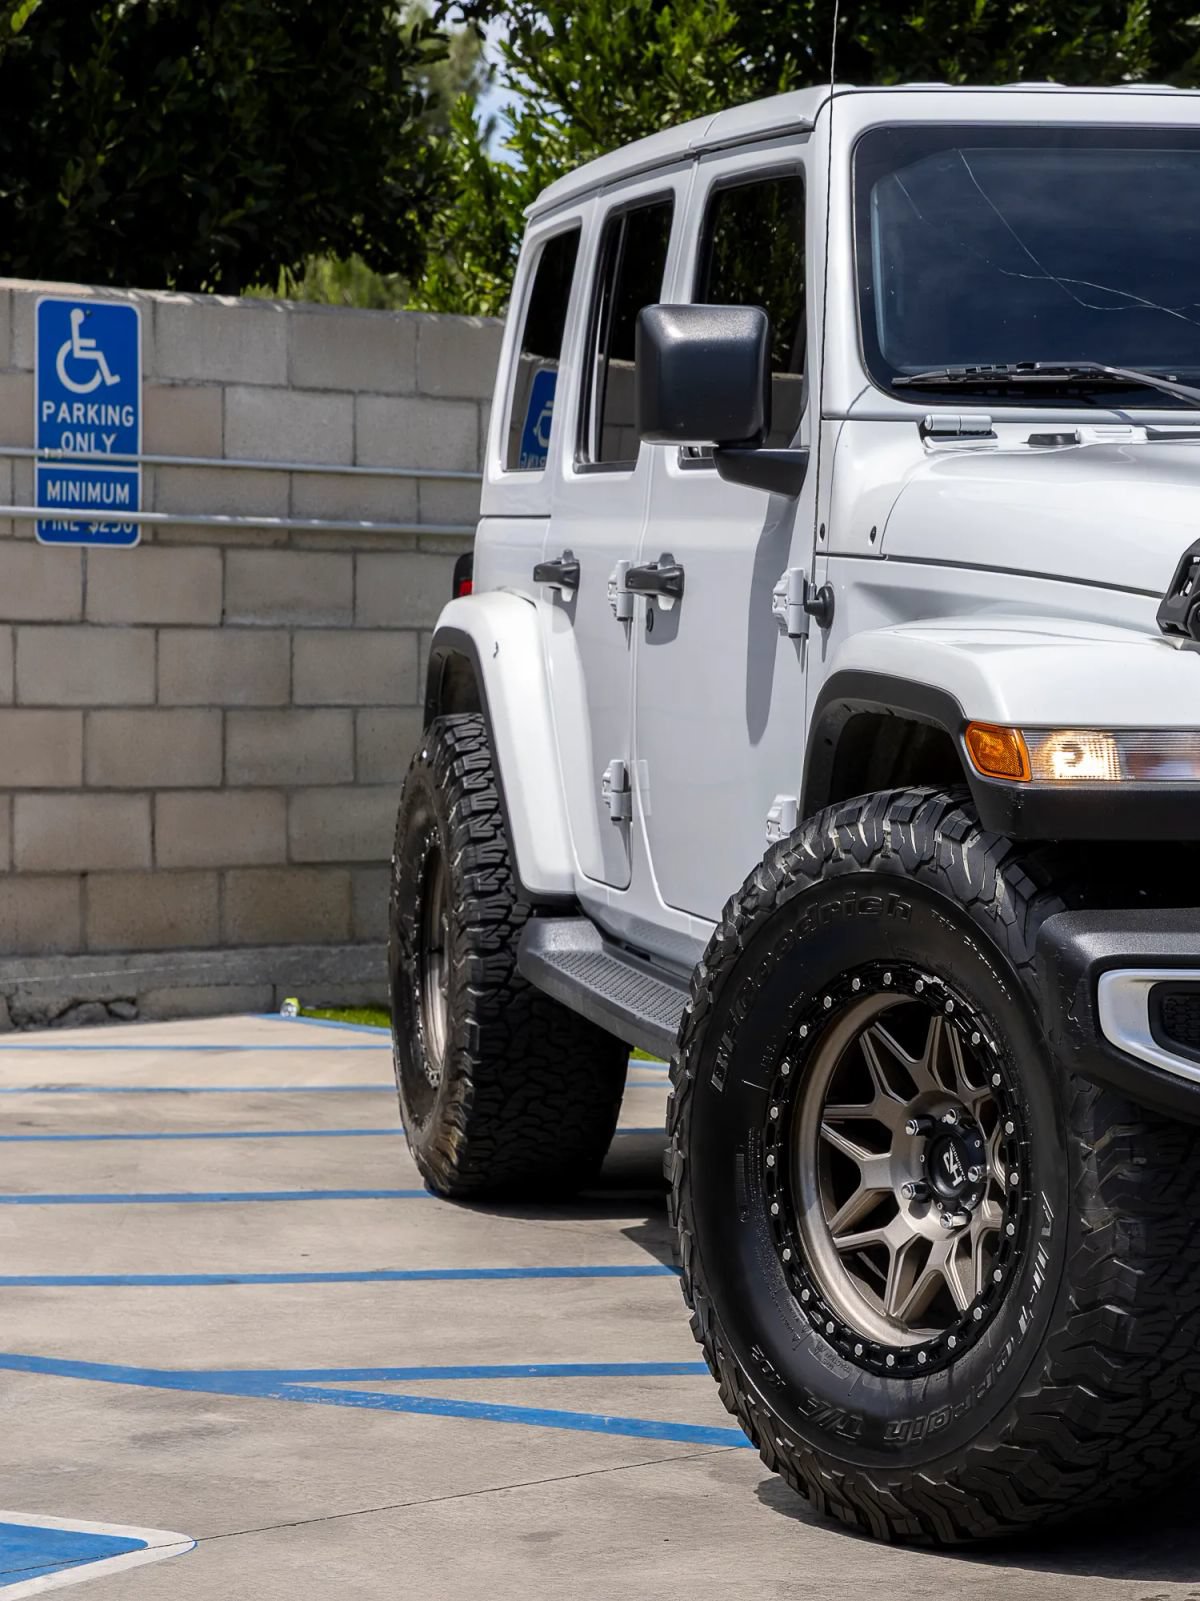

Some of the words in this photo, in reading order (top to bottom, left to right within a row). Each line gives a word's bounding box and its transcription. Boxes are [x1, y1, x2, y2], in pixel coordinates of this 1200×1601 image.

[42, 400, 134, 427] PARKING
[61, 431, 117, 453] ONLY
[47, 480, 130, 504] MINIMUM
